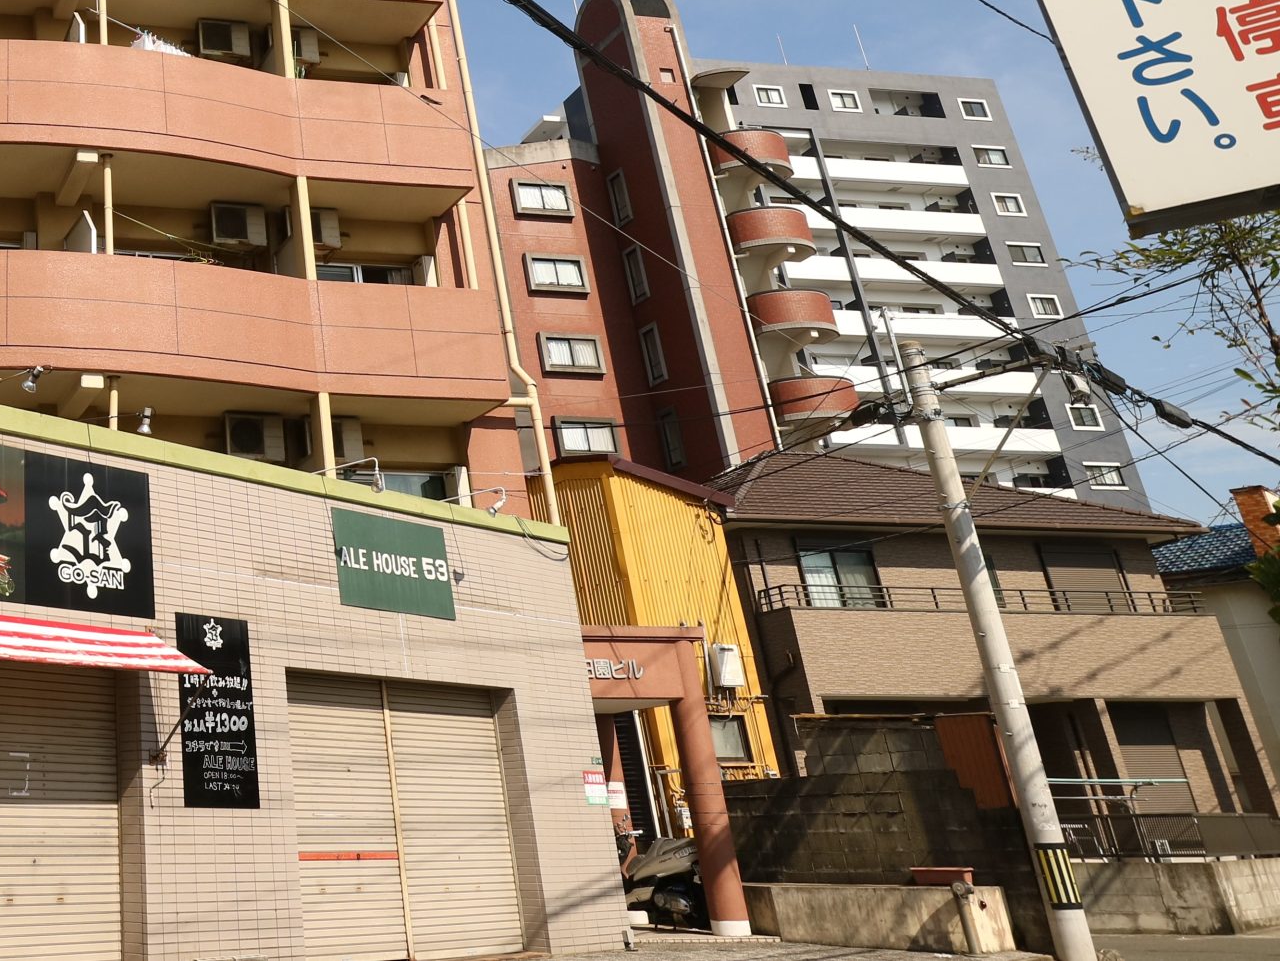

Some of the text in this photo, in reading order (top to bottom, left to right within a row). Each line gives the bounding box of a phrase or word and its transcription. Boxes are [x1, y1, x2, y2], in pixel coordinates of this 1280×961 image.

[340, 546, 449, 582] ALE HOUSE 53
[58, 563, 125, 590] GO-SAN
[202, 754, 256, 771] ALE HOUSE
[203, 771, 220, 779] OPEN
[204, 781, 223, 791] LAST
